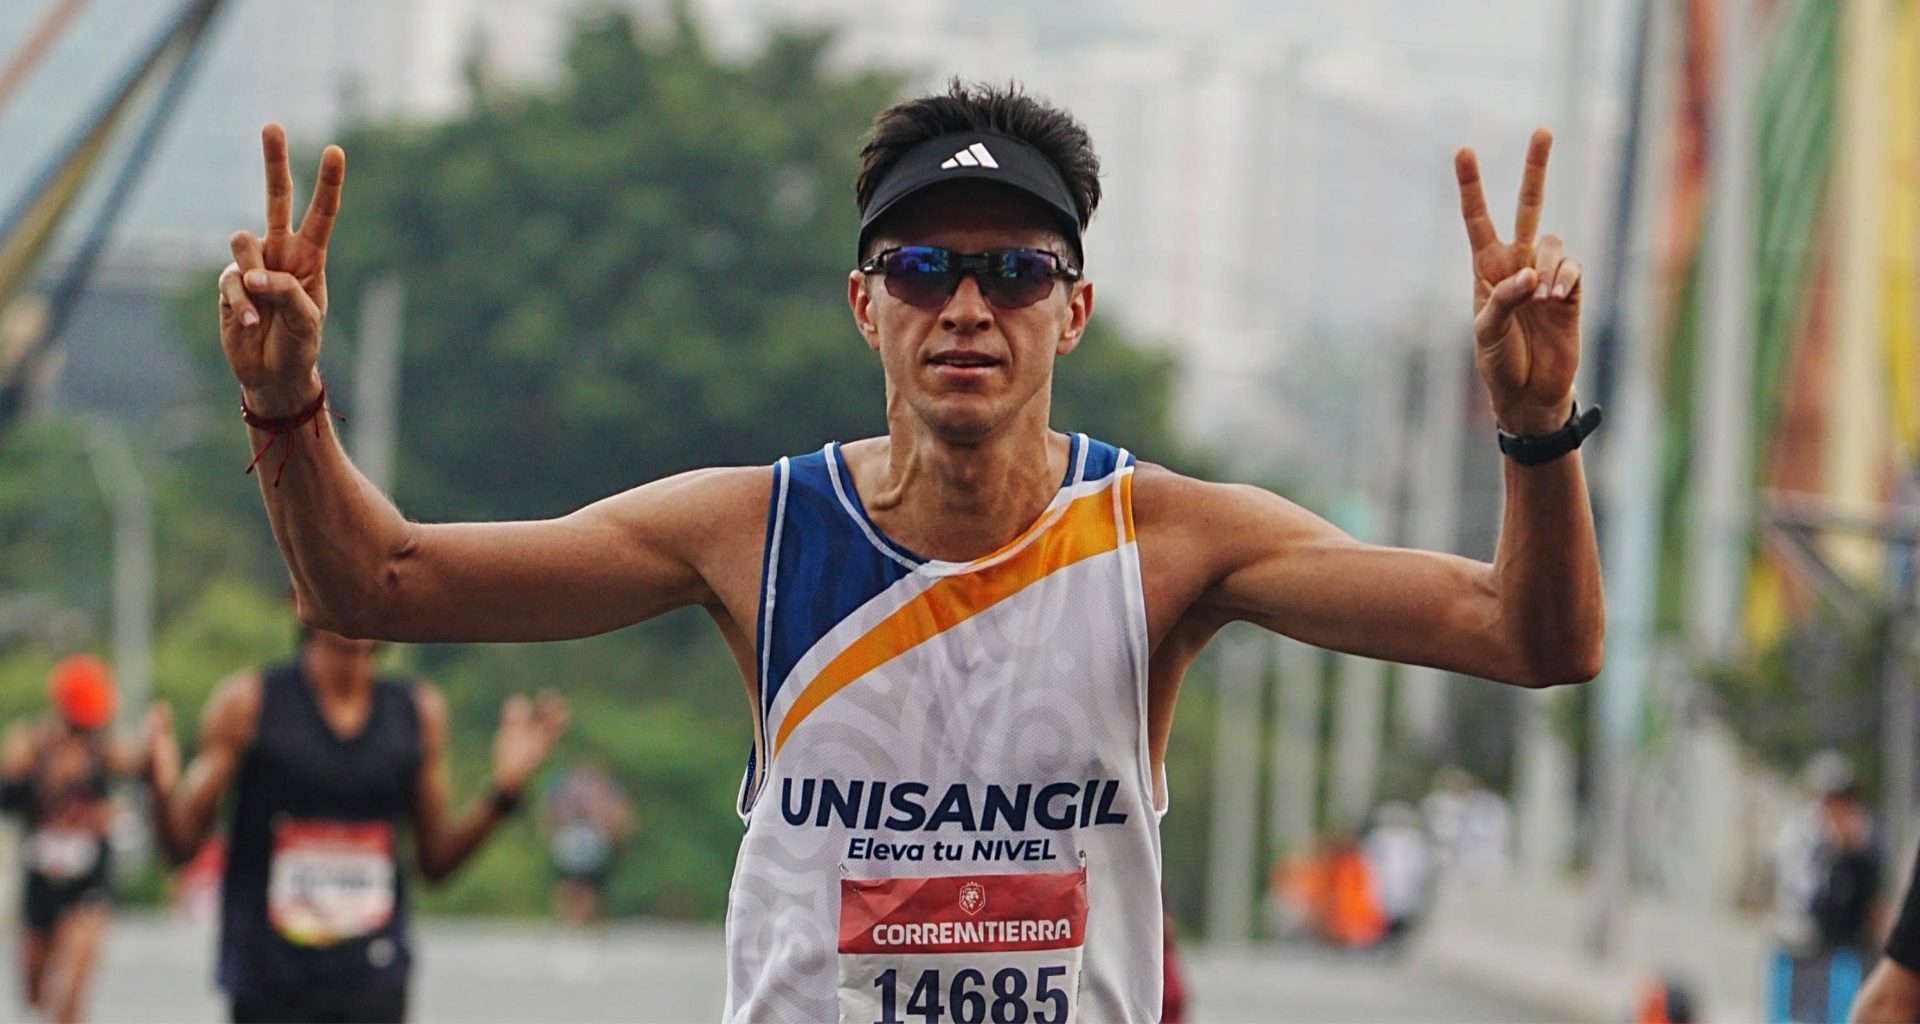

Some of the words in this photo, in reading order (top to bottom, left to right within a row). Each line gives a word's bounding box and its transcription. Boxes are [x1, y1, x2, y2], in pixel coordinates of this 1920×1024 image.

[781, 777, 1128, 831] UNISANGIL
[847, 838, 924, 861] Eleva
[933, 841, 964, 861] tu
[972, 839, 1056, 861] NIVEL
[872, 918, 1072, 945] CORREMITIERRA
[873, 965, 1069, 1024] 14685
